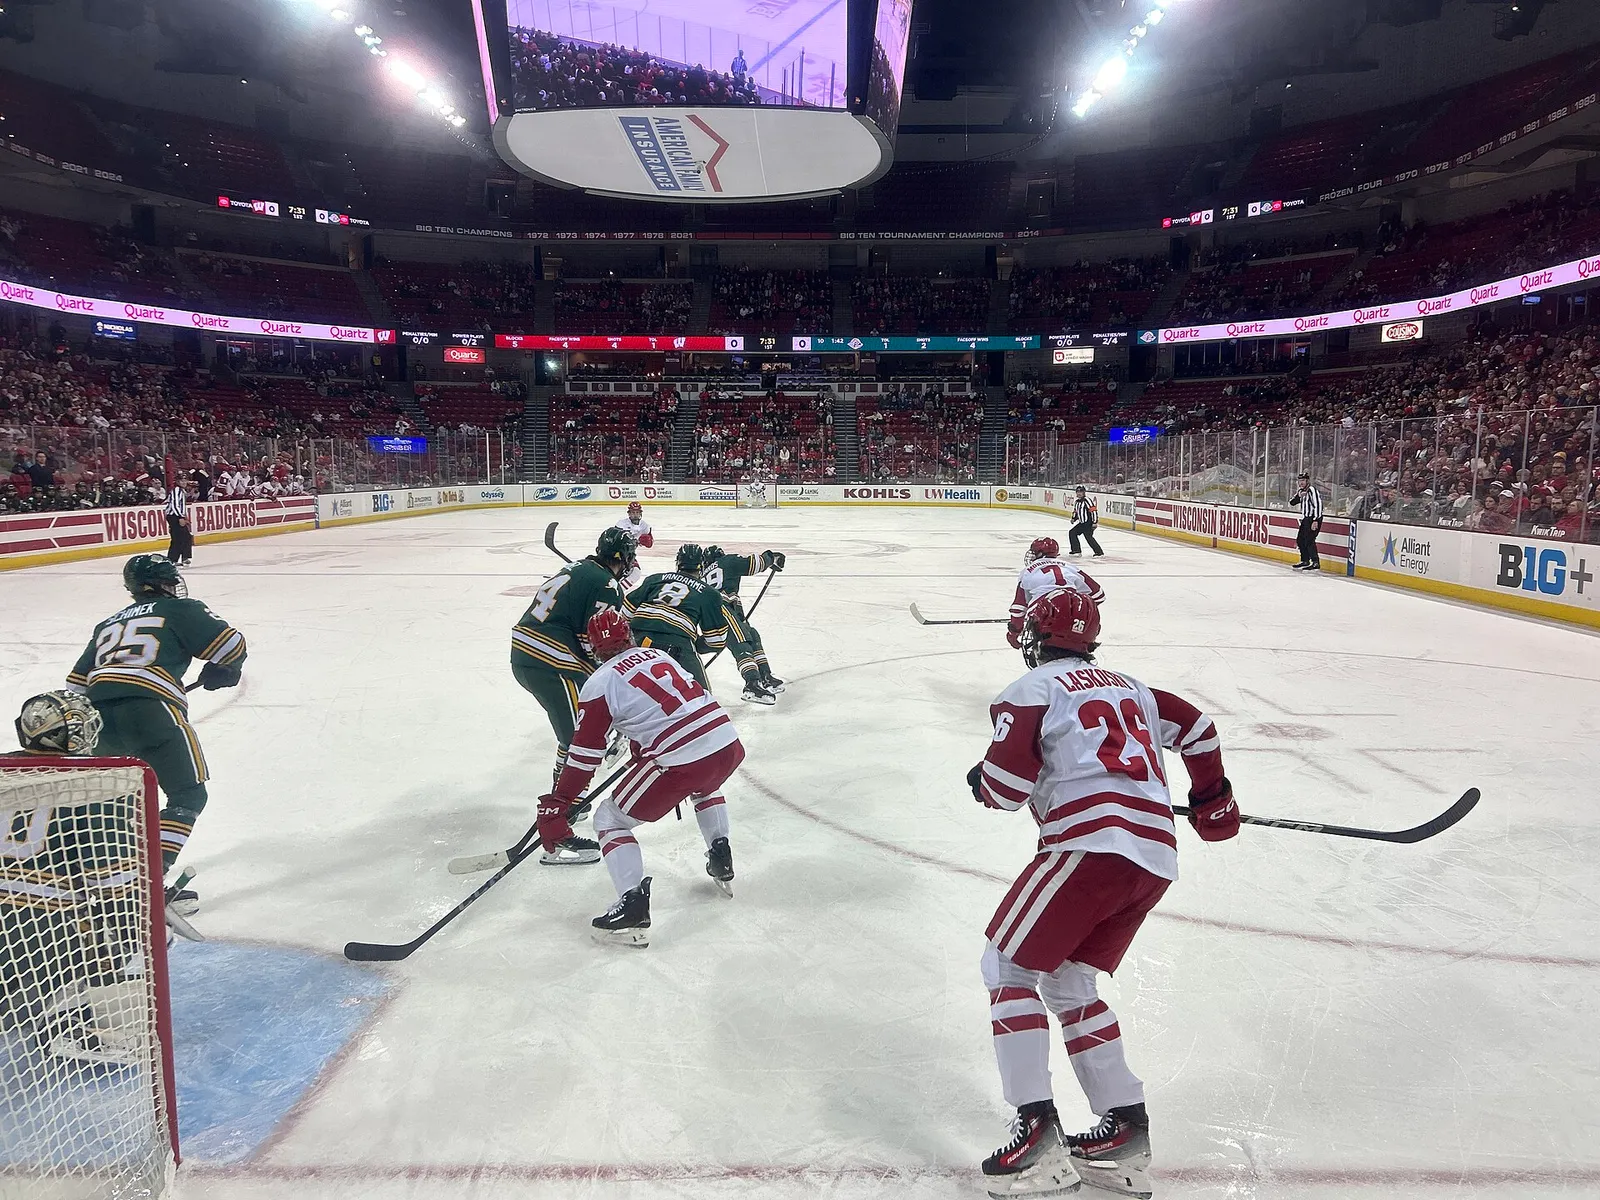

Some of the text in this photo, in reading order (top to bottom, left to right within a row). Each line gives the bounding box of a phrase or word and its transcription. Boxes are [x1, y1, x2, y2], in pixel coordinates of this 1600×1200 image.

[653, 117, 698, 167] AMERICAN
[628, 124, 675, 188] INSURANCE
[62, 161, 88, 175] 2021
[94, 169, 123, 182] 2024
[1320, 186, 1353, 202] FROZEN
[1357, 180, 1383, 193] FOUR
[1394, 168, 1418, 183] 1970
[1424, 160, 1449, 175] 1972
[230, 200, 253, 209] TOYOTA
[288, 206, 306, 215] 7:31
[1222, 206, 1238, 216] 7:31
[416, 224, 513, 239] BIG TEN CHAMPIONS
[528, 231, 549, 240] 1972
[556, 231, 578, 240] 1973
[585, 231, 606, 240] 1974
[614, 231, 635, 240] 1977
[671, 231, 693, 240] 2021
[840, 229, 1039, 239] BIG TEN TOURNAMENT CHAMPIONS 2014
[1520, 270, 1553, 291] Quartz
[0, 281, 34, 300] Quartz
[1470, 285, 1499, 304] Quartz
[56, 294, 94, 311] Quartz
[1418, 297, 1451, 314] Quartz
[124, 304, 165, 321] Quartz
[192, 312, 229, 328] Quartz
[1353, 307, 1389, 323] Quartz
[261, 320, 302, 335] Quartz
[1227, 322, 1265, 337] Quartz
[1295, 316, 1328, 331] Quartz
[330, 326, 369, 341] Quartz
[412, 337, 429, 345] 0/0
[1102, 337, 1118, 345] 2/4
[1164, 326, 1199, 341] Quartz
[461, 338, 478, 346] 0/2
[1057, 339, 1073, 347] 0/0
[450, 350, 478, 360] Quartz
[481, 491, 504, 499] Odyssey
[843, 488, 912, 499] KOHL'S
[195, 502, 256, 533] BADGERS
[1172, 504, 1217, 537] WISCONSIN
[1219, 510, 1269, 545] BADGERS
[1401, 537, 1431, 557] Alliant
[1400, 554, 1430, 575] Energy
[661, 572, 706, 593] VANDAMME
[1040, 565, 1067, 587] 7
[653, 582, 690, 607] 8
[601, 629, 611, 639] 12
[1071, 618, 1086, 634] 26
[95, 616, 166, 668] 25
[612, 649, 661, 676] MOSLEY
[628, 662, 706, 717] 12
[1007, 1143, 1031, 1166] BAUER
[1087, 1142, 1114, 1155] BAUER
